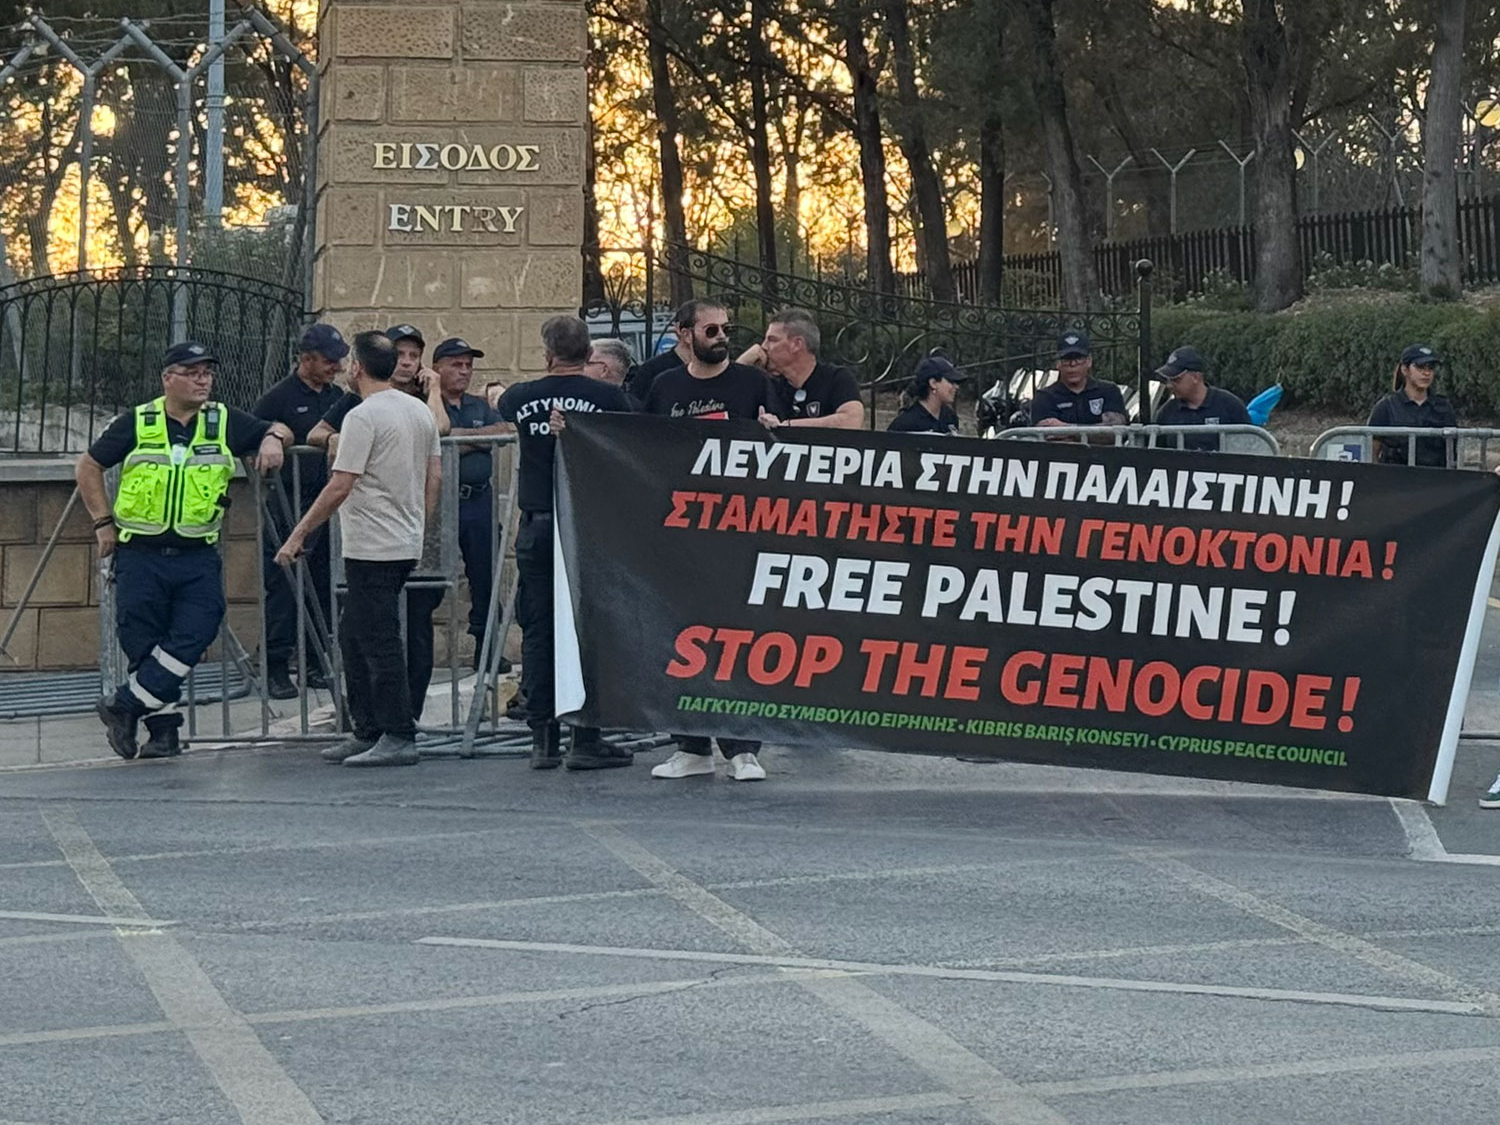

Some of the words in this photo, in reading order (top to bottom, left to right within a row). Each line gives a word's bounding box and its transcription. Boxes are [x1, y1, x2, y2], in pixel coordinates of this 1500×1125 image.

[373, 142, 540, 171] ΕΙΣΟΔΟΣ
[388, 204, 524, 233] ENTRY
[691, 438, 903, 489] ΛΕΥΤΕΡΙΑ
[915, 453, 1039, 500] ΣΤΗΝ
[1045, 461, 1356, 521] ΠΑΛΑΙΣΤΙΝΗ!
[664, 491, 961, 548] ΣΤΑΜΑΤΗΣΤΕ
[970, 511, 1066, 556] ΤΗΝ
[1076, 518, 1398, 580] ΓΕΝΟΚΤΟΝΙΑ!
[747, 552, 910, 615] FREE
[921, 564, 1298, 647] PALESTINE!
[665, 625, 843, 689] STOP
[860, 639, 989, 701] THE
[1000, 650, 1361, 733] GENOCIDE!
[677, 695, 778, 718] ΠΑΓΚΥΠΡΙΟ
[778, 706, 881, 727] ΣΥΜΒΟΥΛΙΟ
[881, 713, 958, 733] ΕΙΡΗΝΗΣ
[966, 719, 1023, 738] KIBRIS
[1024, 723, 1075, 746] BARIŞ
[1157, 734, 1222, 755] CYPRUS
[1223, 740, 1276, 761] PEACE
[1277, 745, 1348, 768] COUNCIL
